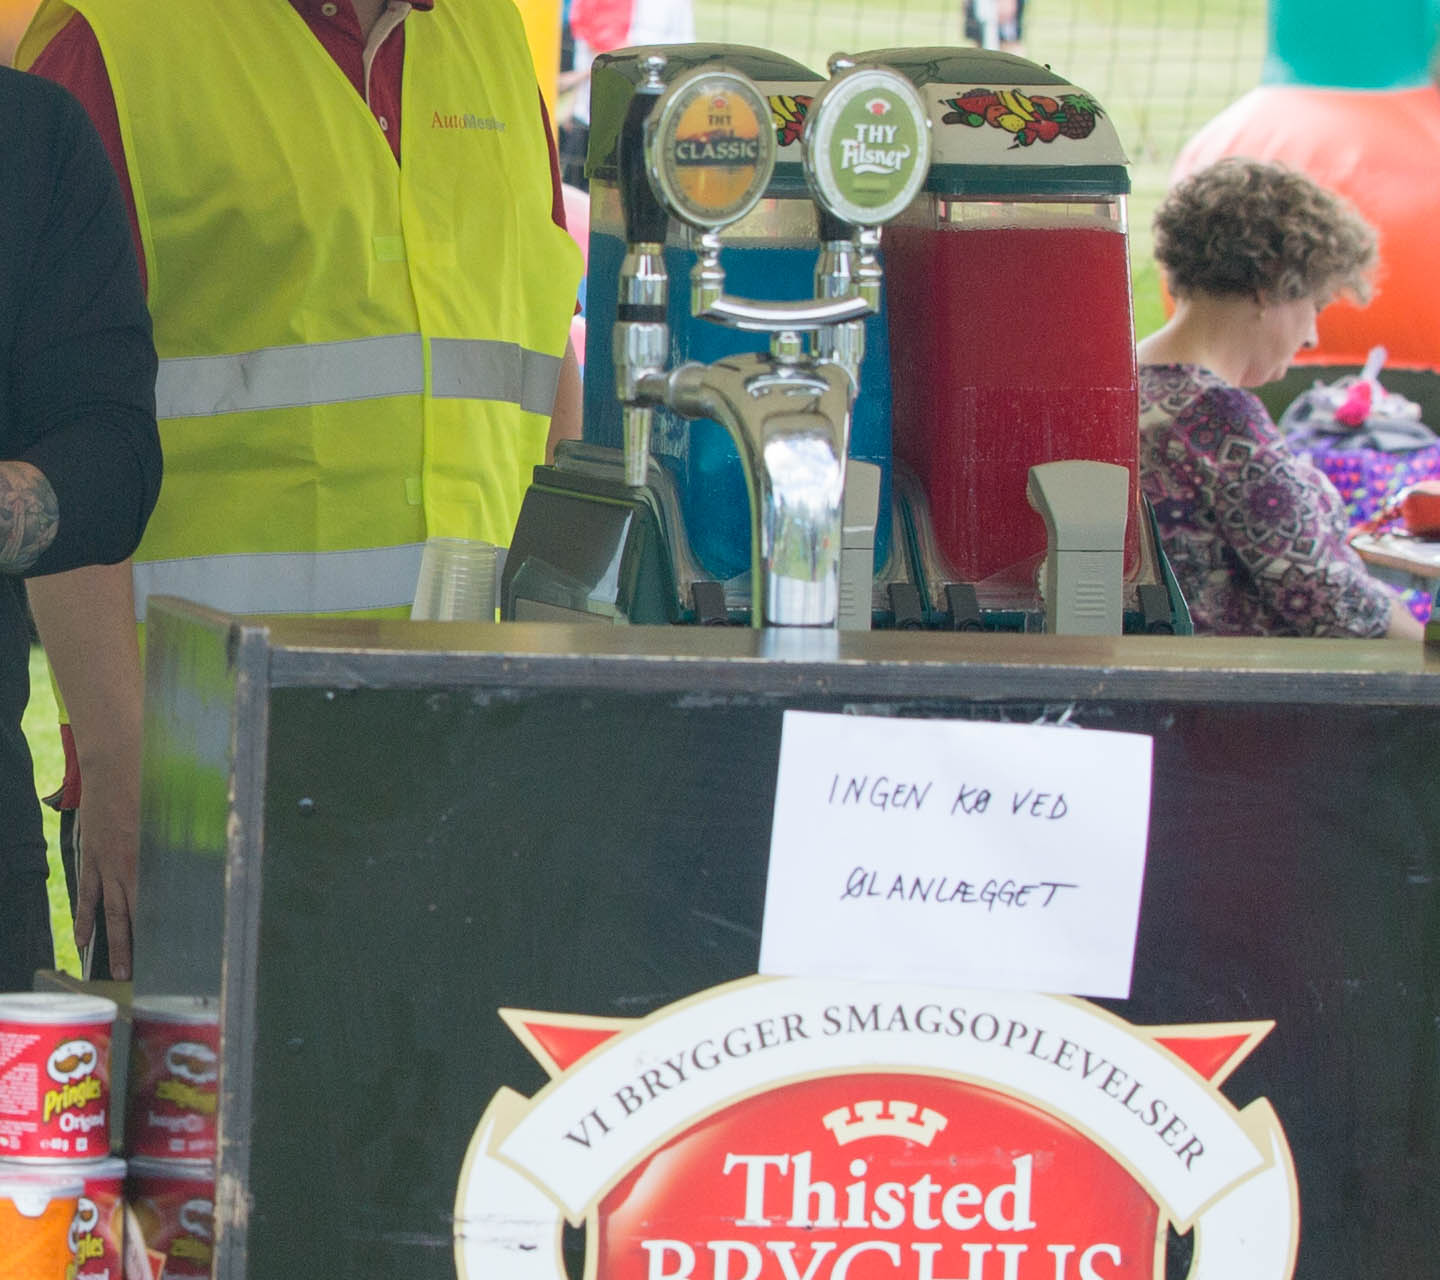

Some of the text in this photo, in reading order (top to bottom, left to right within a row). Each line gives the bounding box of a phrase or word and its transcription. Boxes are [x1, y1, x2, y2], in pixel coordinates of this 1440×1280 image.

[676, 141, 758, 161] CLASSIC
[839, 138, 911, 170] Pilsner
[853, 123, 898, 144] THY
[828, 772, 933, 813] INGEN
[1011, 788, 1069, 821] VED
[840, 866, 1080, 912] ØLANLÆGGET
[43, 1076, 102, 1123] Pringles
[562, 1003, 1210, 1174] VI BRYGGER SMAGSOPLEVELSER
[722, 1151, 1037, 1232] Thisted
[77, 1233, 104, 1265] gles
